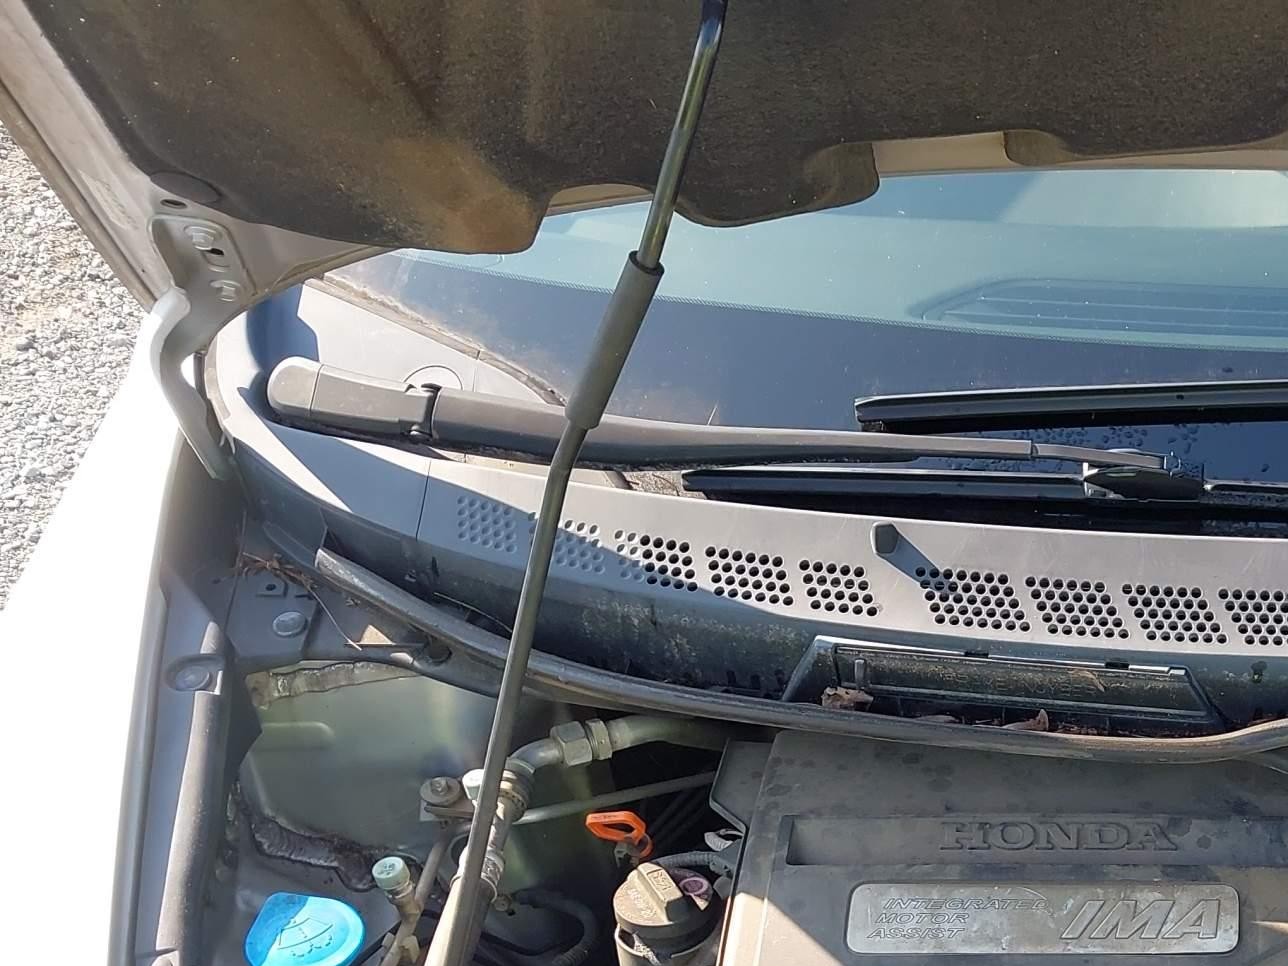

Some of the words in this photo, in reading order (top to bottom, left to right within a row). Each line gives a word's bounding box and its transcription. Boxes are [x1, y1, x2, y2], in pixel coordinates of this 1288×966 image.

[940, 821, 1177, 851] HONDA
[882, 897, 1048, 911] INTEGRATED
[874, 912, 969, 925] MOTOR
[1060, 899, 1221, 940] IMA
[867, 927, 965, 940] ASSIST
